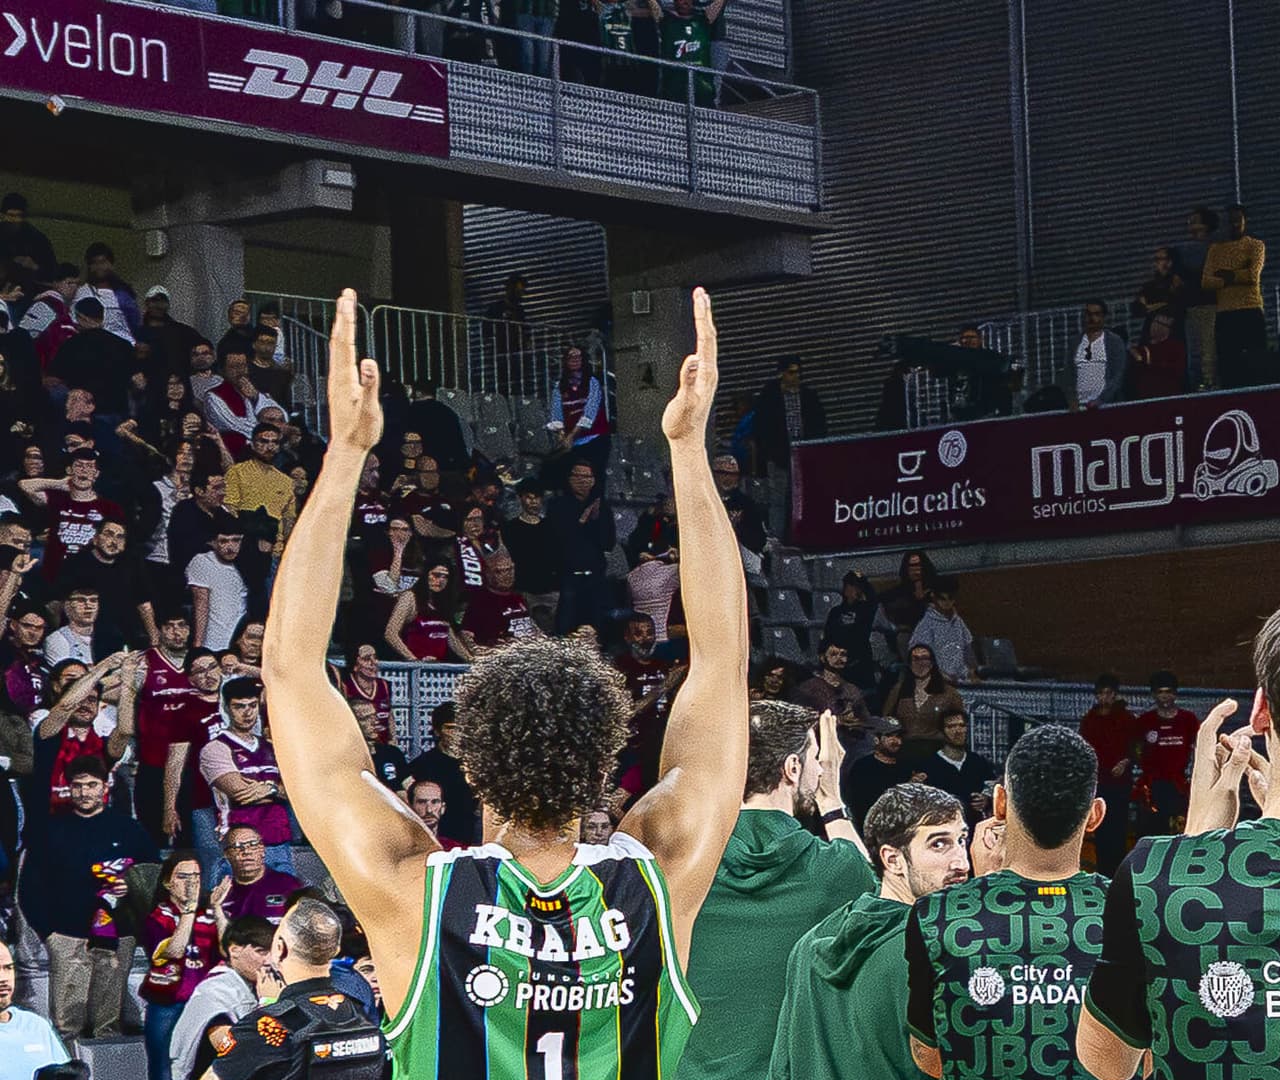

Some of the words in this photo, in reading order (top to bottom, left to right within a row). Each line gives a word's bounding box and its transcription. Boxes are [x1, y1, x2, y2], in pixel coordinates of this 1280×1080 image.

[31, 13, 169, 82] velon
[242, 48, 414, 119] DHL
[1031, 416, 1185, 511] margi
[834, 492, 919, 524] batalla
[923, 480, 986, 512] cafés
[1032, 496, 1107, 520] servicios
[468, 903, 632, 963] KRAAG
[515, 979, 635, 1012] PROBITAS
[1010, 965, 1049, 987] City
[1052, 964, 1074, 982] of
